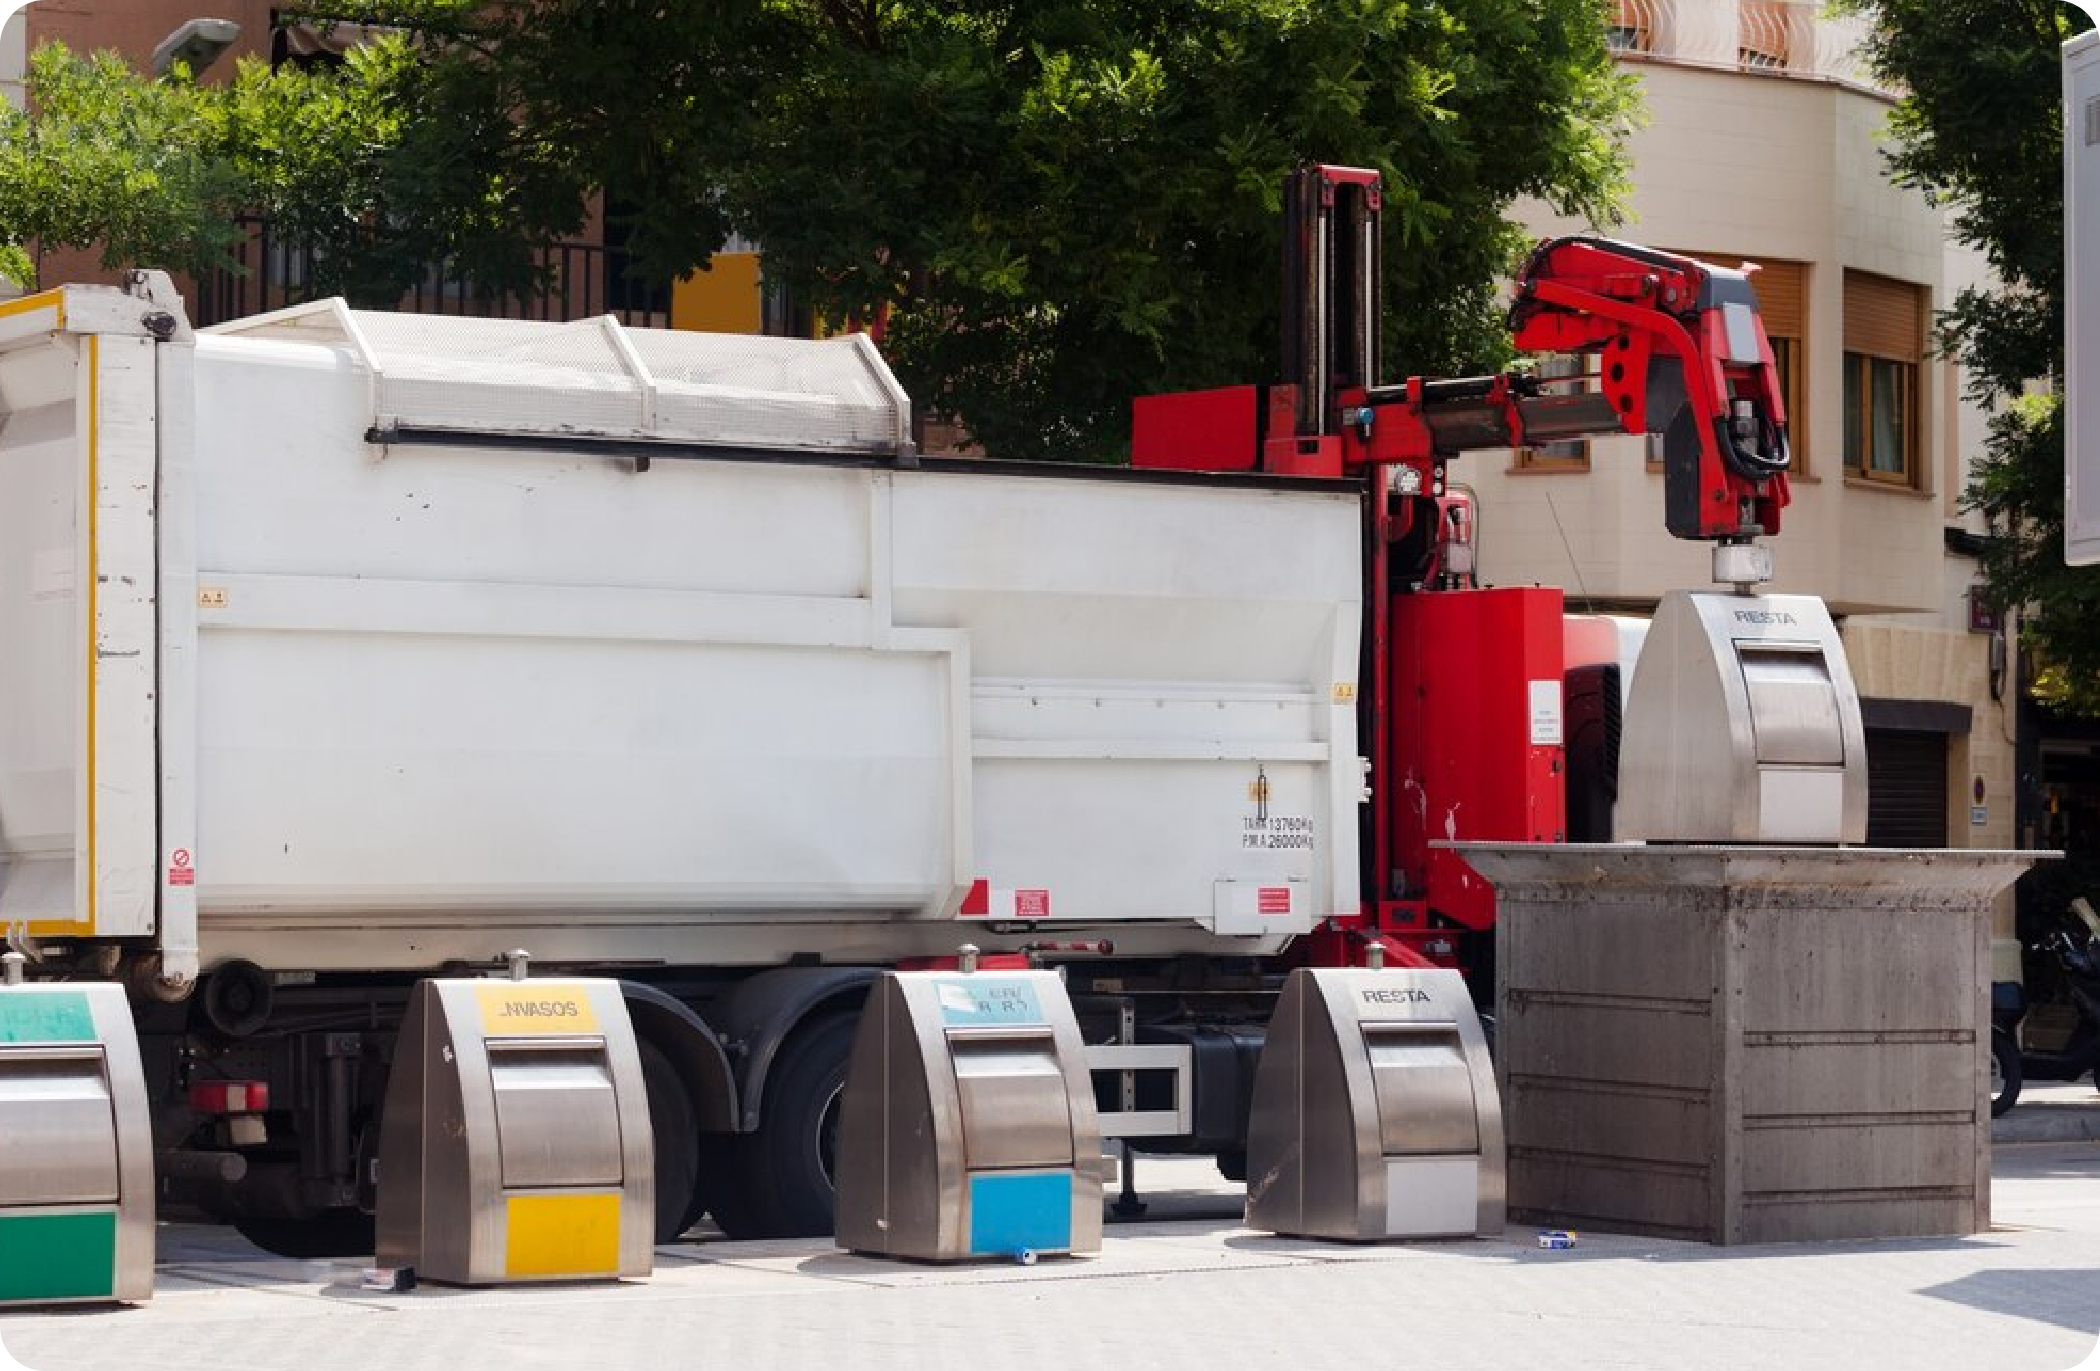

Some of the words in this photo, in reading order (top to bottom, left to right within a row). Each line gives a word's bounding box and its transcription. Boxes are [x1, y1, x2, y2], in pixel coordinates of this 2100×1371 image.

[1733, 610, 1797, 627] RESTA
[1361, 988, 1431, 1004] RESTA
[498, 1000, 579, 1017] NVASOS
